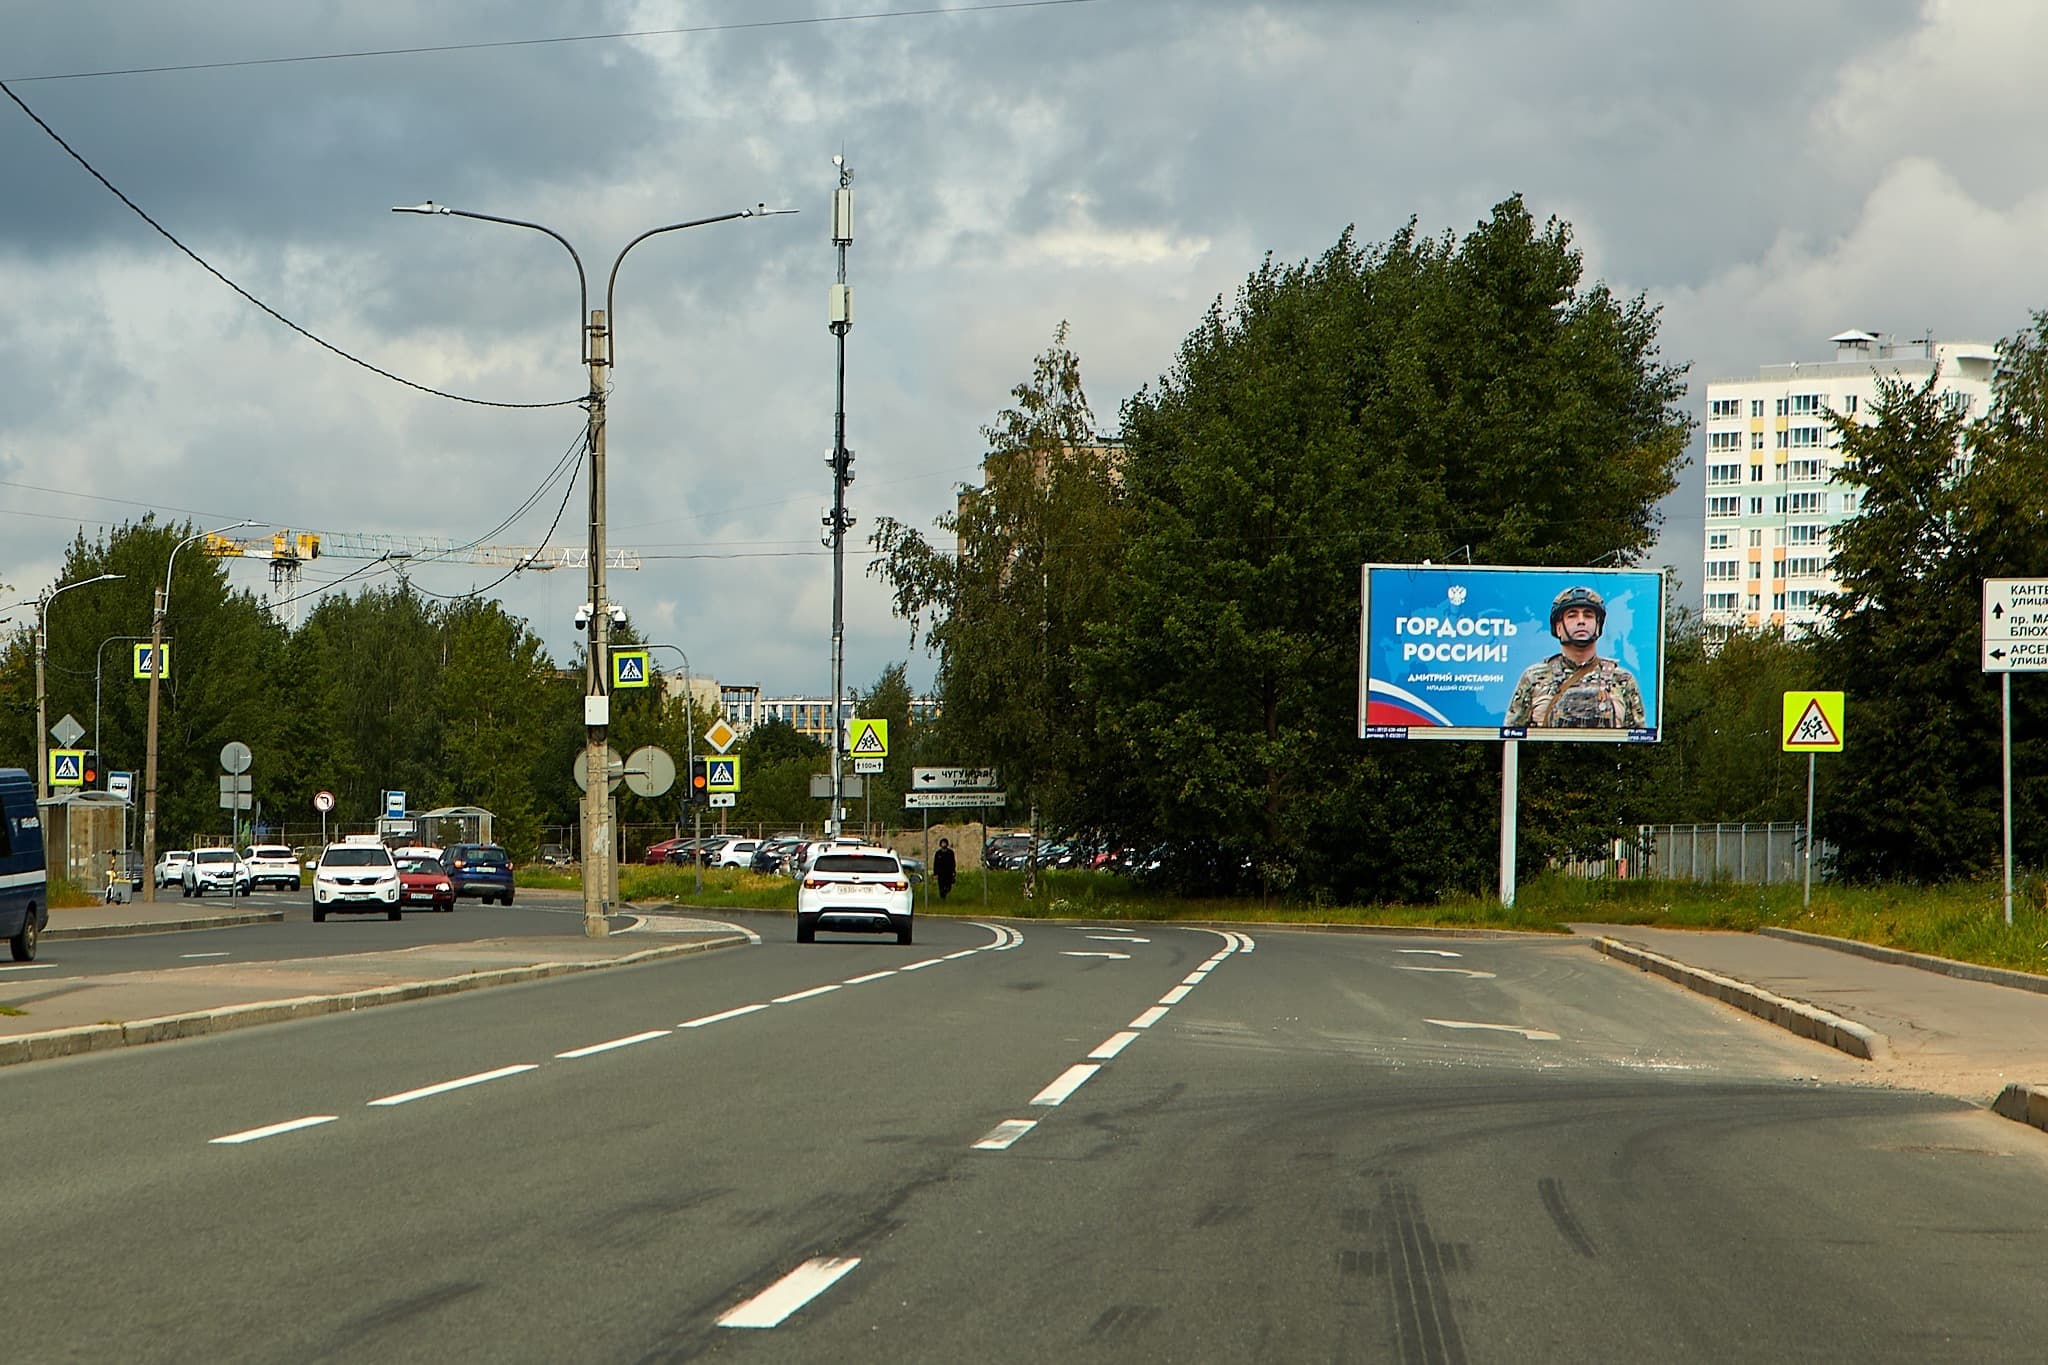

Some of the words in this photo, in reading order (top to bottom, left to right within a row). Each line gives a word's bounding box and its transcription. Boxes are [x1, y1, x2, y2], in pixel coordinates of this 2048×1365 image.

[2012, 597, 2048, 608] улица
[2010, 616, 2029, 625] пр.
[1395, 617, 1518, 637] ГОРДОСТЬ
[2010, 627, 2048, 637] БЛЮХ
[1403, 643, 1508, 663] РОССИИ!
[2010, 656, 2047, 667] улица
[1408, 672, 1452, 682] ДМИТРИЙ
[1454, 674, 1504, 683] МУСТАФИН
[952, 779, 978, 787] улица
